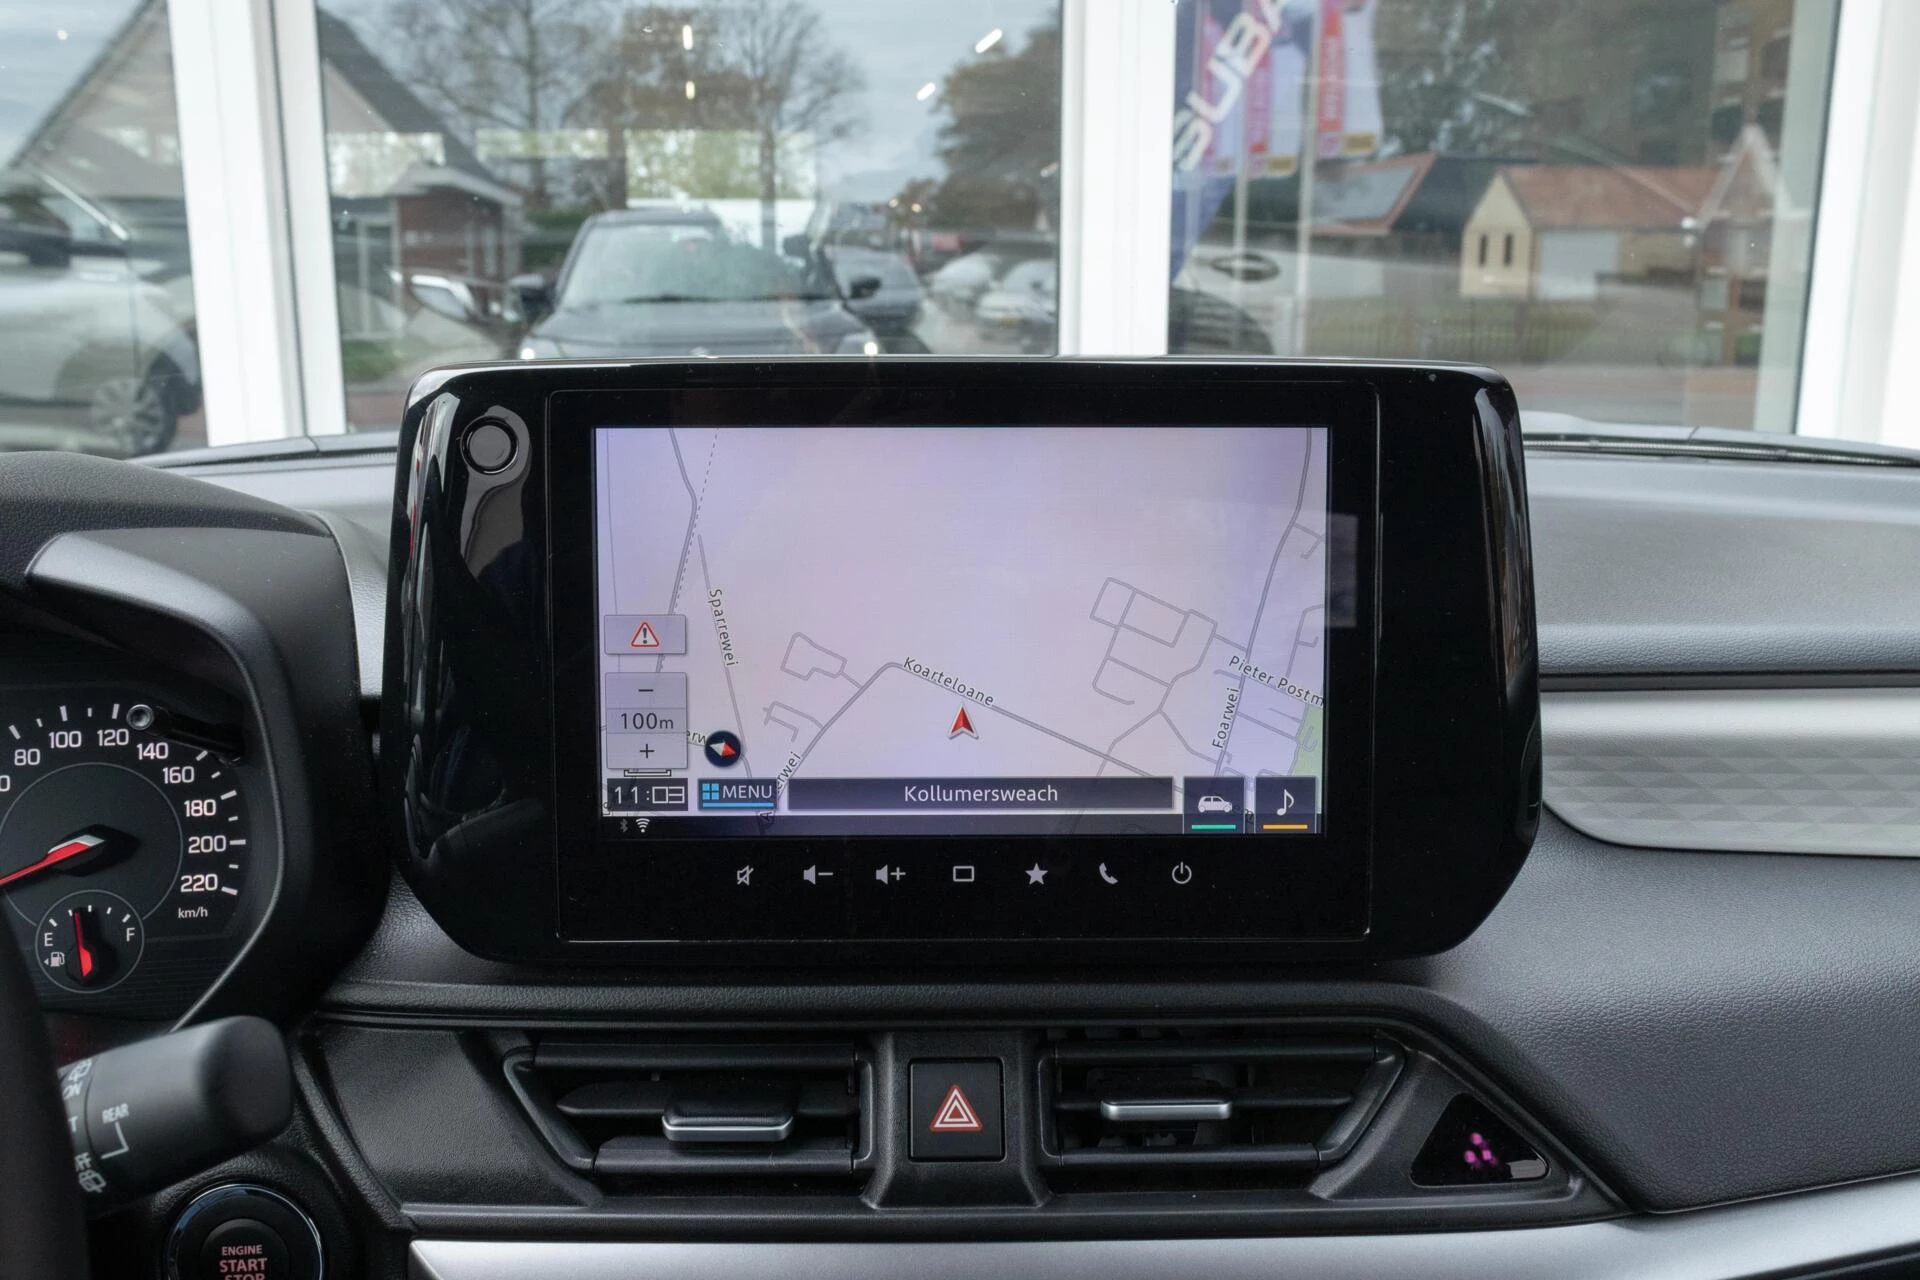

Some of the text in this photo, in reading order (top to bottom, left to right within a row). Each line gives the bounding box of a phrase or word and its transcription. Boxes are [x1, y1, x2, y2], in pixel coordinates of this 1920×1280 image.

[709, 588, 739, 667] Sparrewei
[903, 656, 994, 706] Koarteloane
[1229, 655, 1324, 706] Pieter Postm
[620, 712, 674, 730] 100m
[1212, 687, 1240, 749] Foarwei
[49, 731, 82, 749] 100
[97, 729, 129, 746] 120
[14, 748, 40, 766] 80
[137, 742, 169, 760] 140
[162, 766, 195, 784] 160
[722, 785, 772, 799] MENU
[904, 784, 1058, 802] Kollumersweach
[184, 799, 216, 817] 180
[188, 835, 227, 853] 200
[180, 873, 218, 892] 220
[177, 907, 208, 919] km/h
[43, 932, 54, 947] E
[126, 927, 136, 942] F
[102, 1103, 129, 1123] REAR
[221, 1244, 263, 1256] ENGINE
[219, 1257, 268, 1273] START
